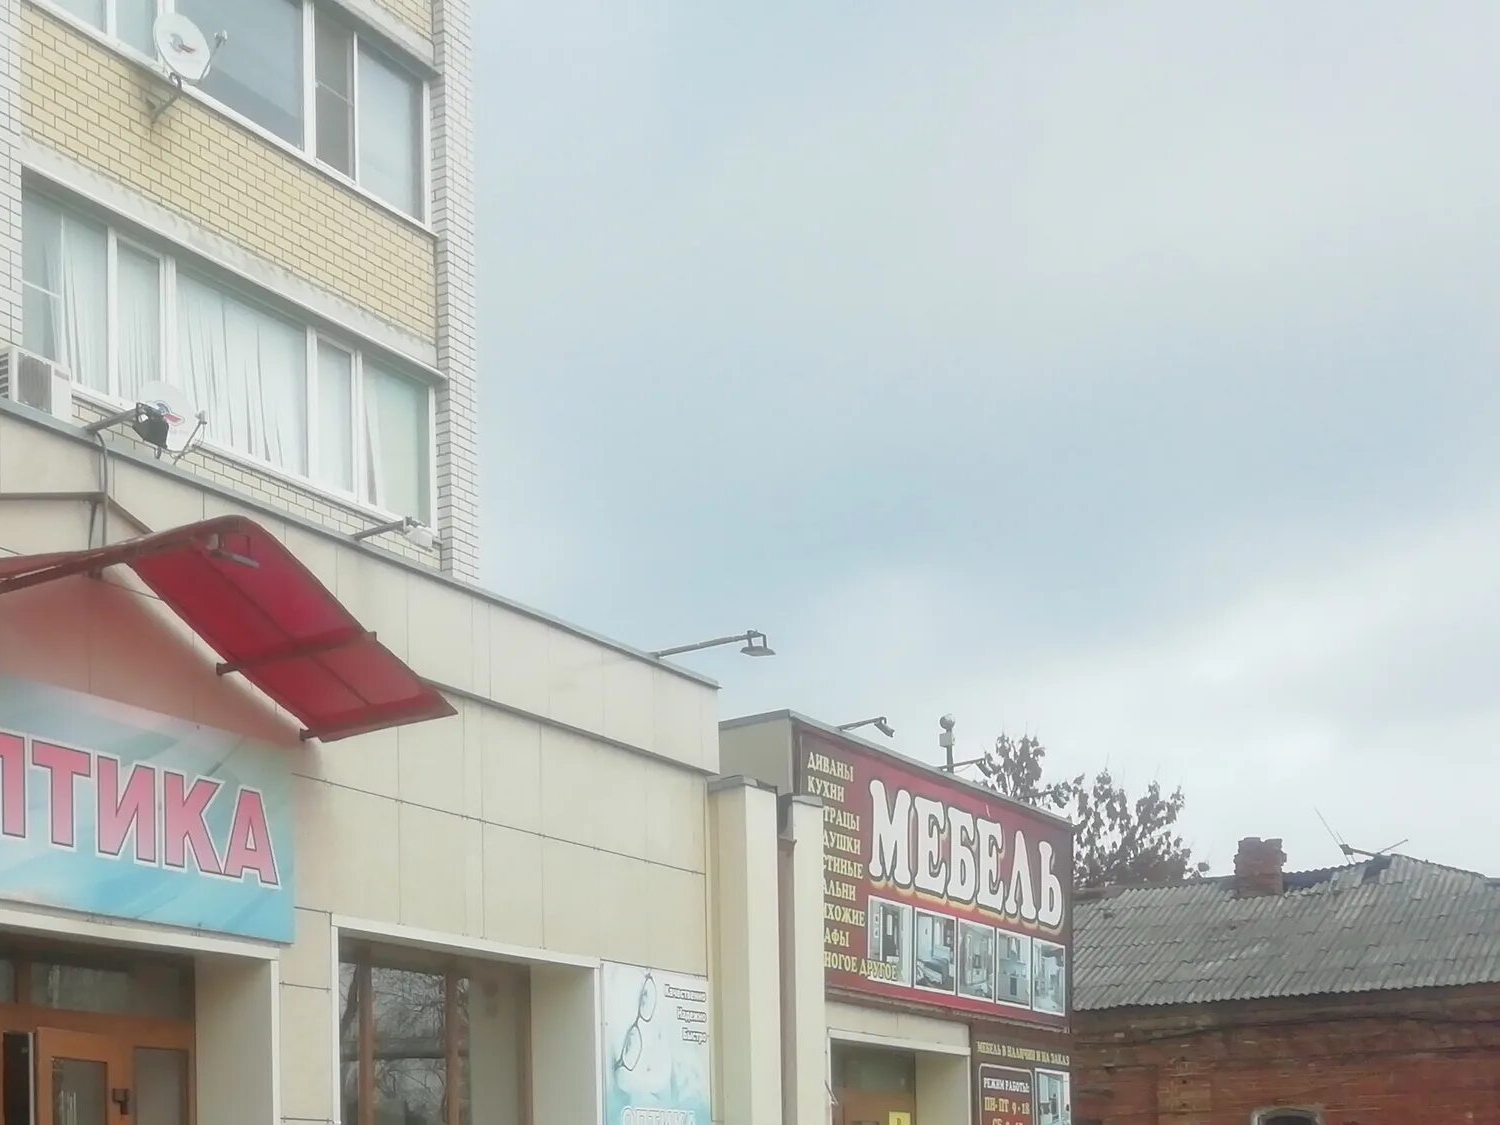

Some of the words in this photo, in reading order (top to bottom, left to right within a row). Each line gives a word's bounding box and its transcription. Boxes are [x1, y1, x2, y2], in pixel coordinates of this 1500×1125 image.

[807, 752, 854, 782] ДИВАНЫ
[807, 775, 845, 803] КУХНИ
[869, 779, 1063, 927] МЕБЕЛЬ
[859, 958, 897, 980] ДРУГОЕ
[977, 1041, 1001, 1056] МЕБЕЛЬ
[1002, 1045, 1007, 1057] В
[1051, 1053, 1070, 1066] ЗАКАЗ
[983, 1077, 1004, 1091] РЕЖИМ
